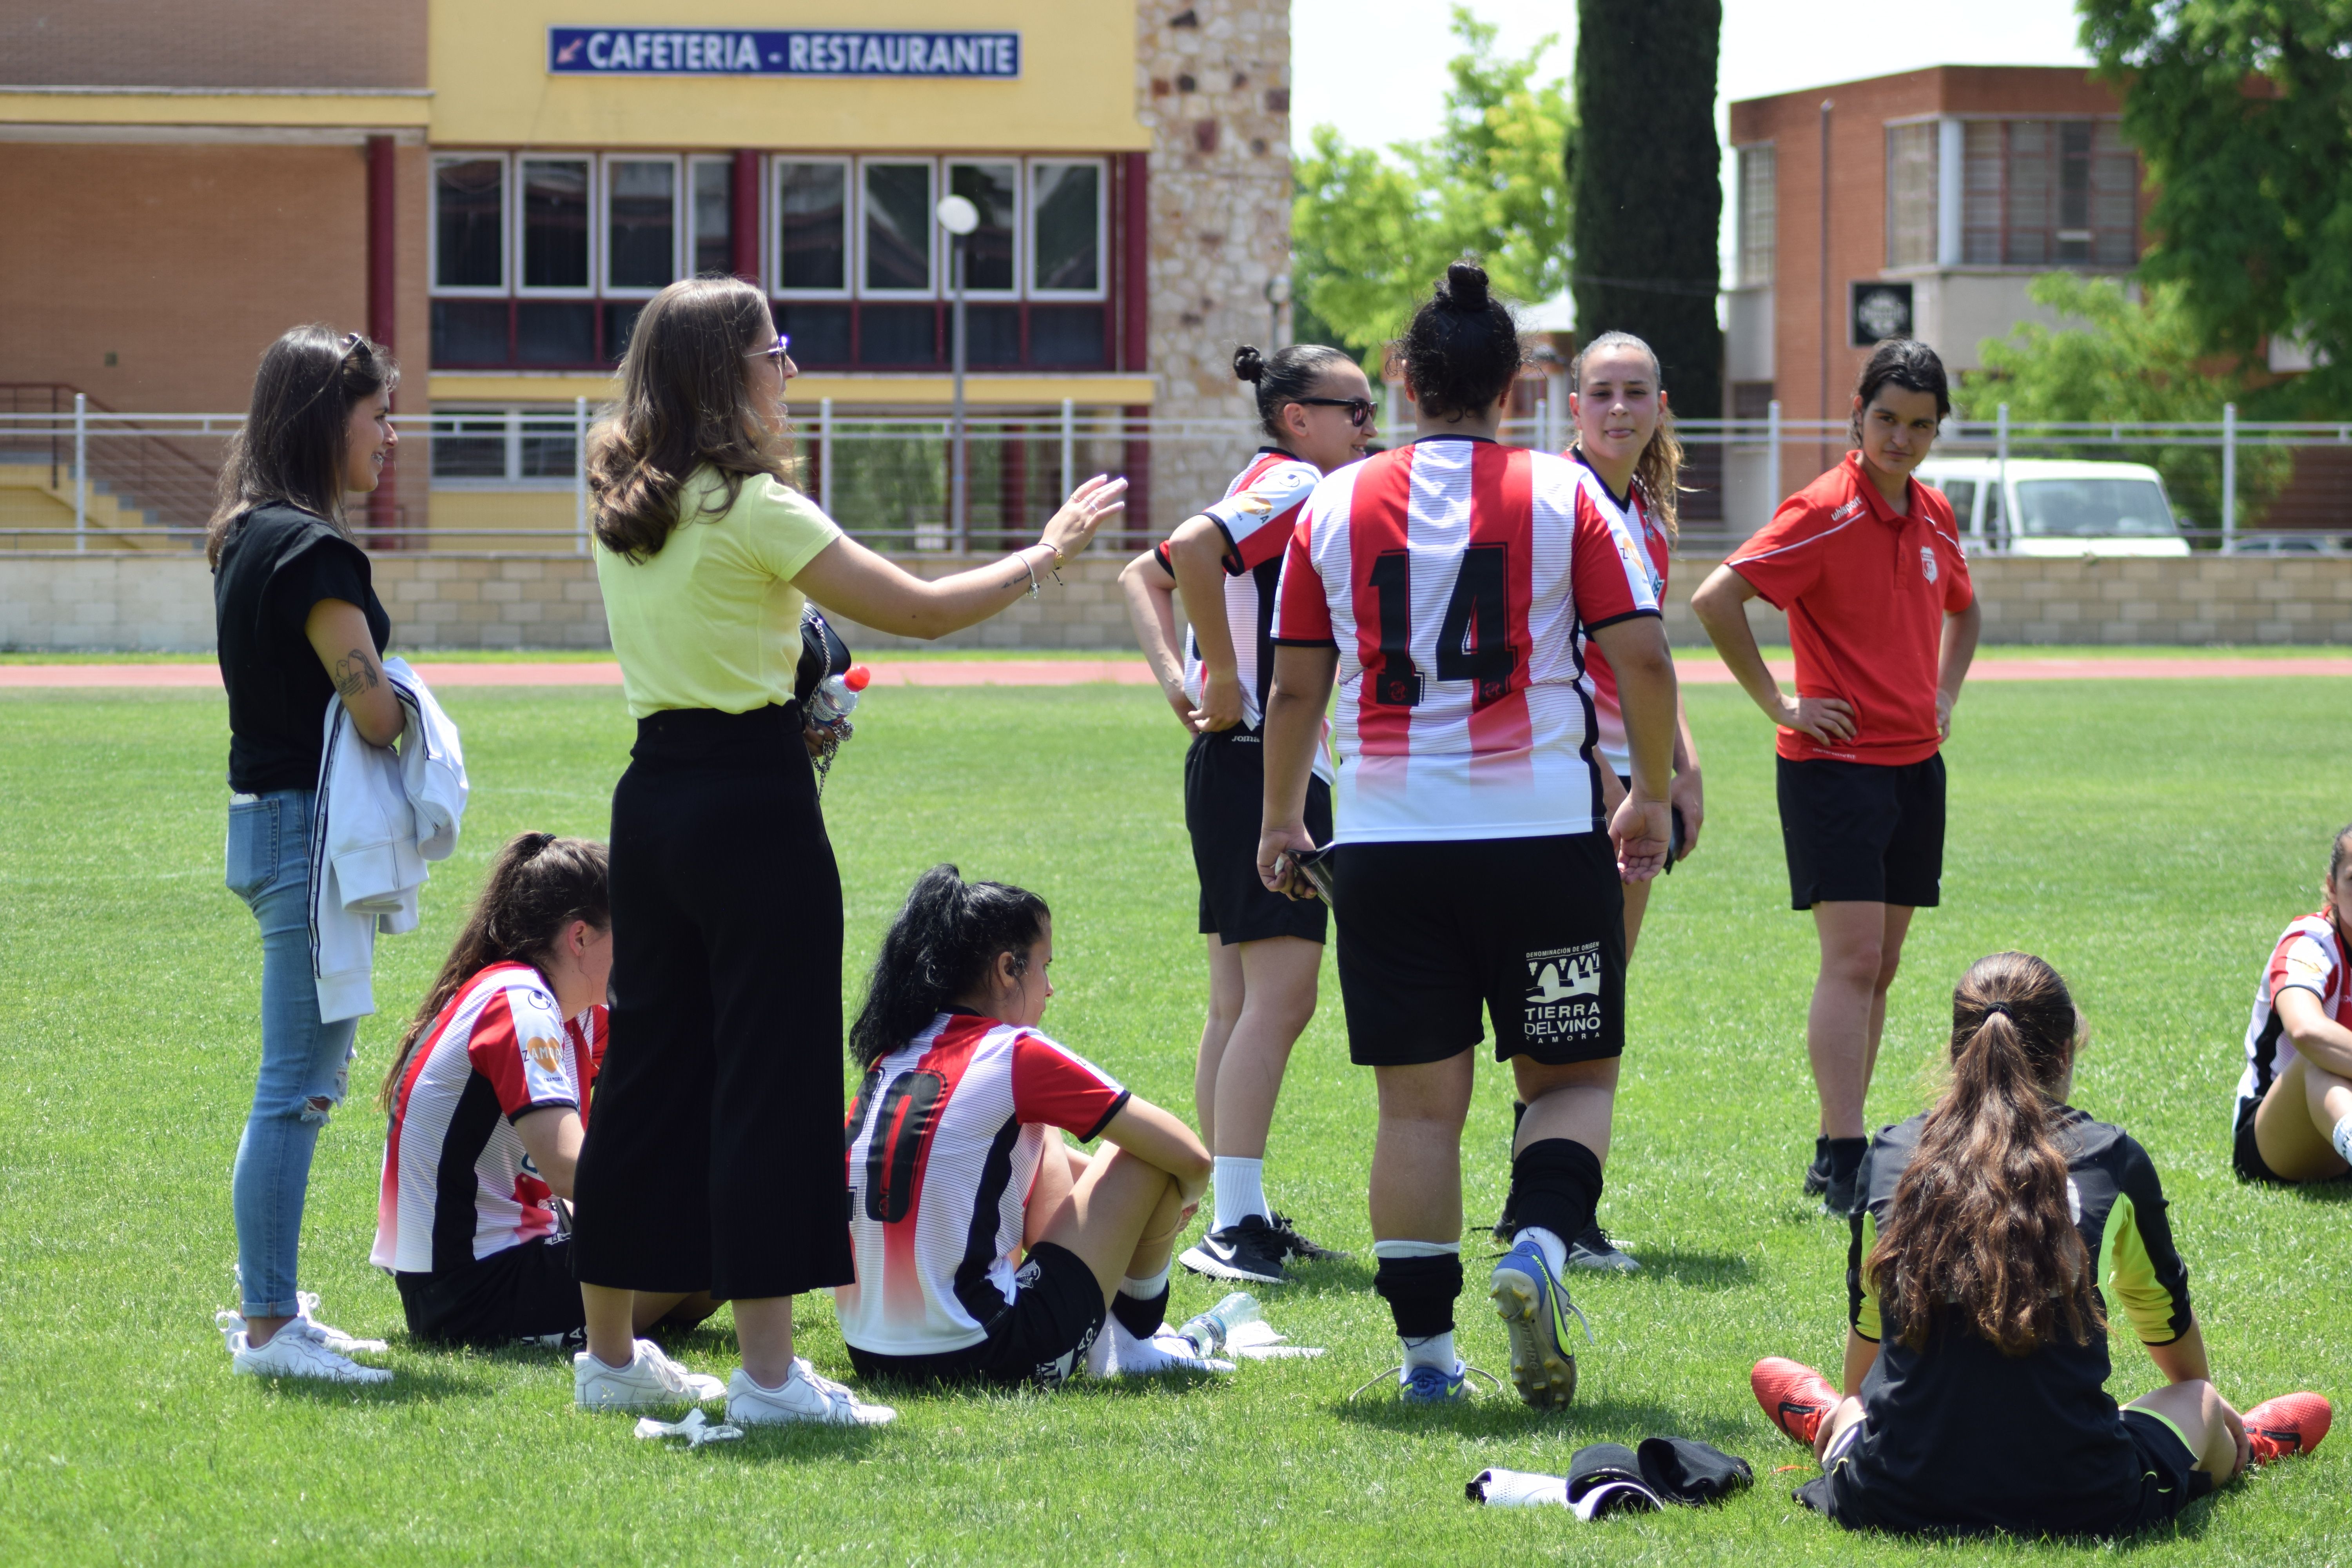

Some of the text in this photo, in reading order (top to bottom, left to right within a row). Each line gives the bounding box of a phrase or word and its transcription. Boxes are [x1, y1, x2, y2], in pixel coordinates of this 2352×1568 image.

[586, 33, 760, 70] CAFETERIA
[788, 36, 1014, 72] RESTAURANTE
[1831, 496, 1862, 521] uhlsport
[1368, 542, 1518, 706] 14
[1526, 947, 1571, 958] DENOMINACIÓN
[1581, 941, 1599, 951] ORIGEN
[1524, 1002, 1600, 1020] TIERRA
[1526, 1032, 1600, 1044] ZAMORA
